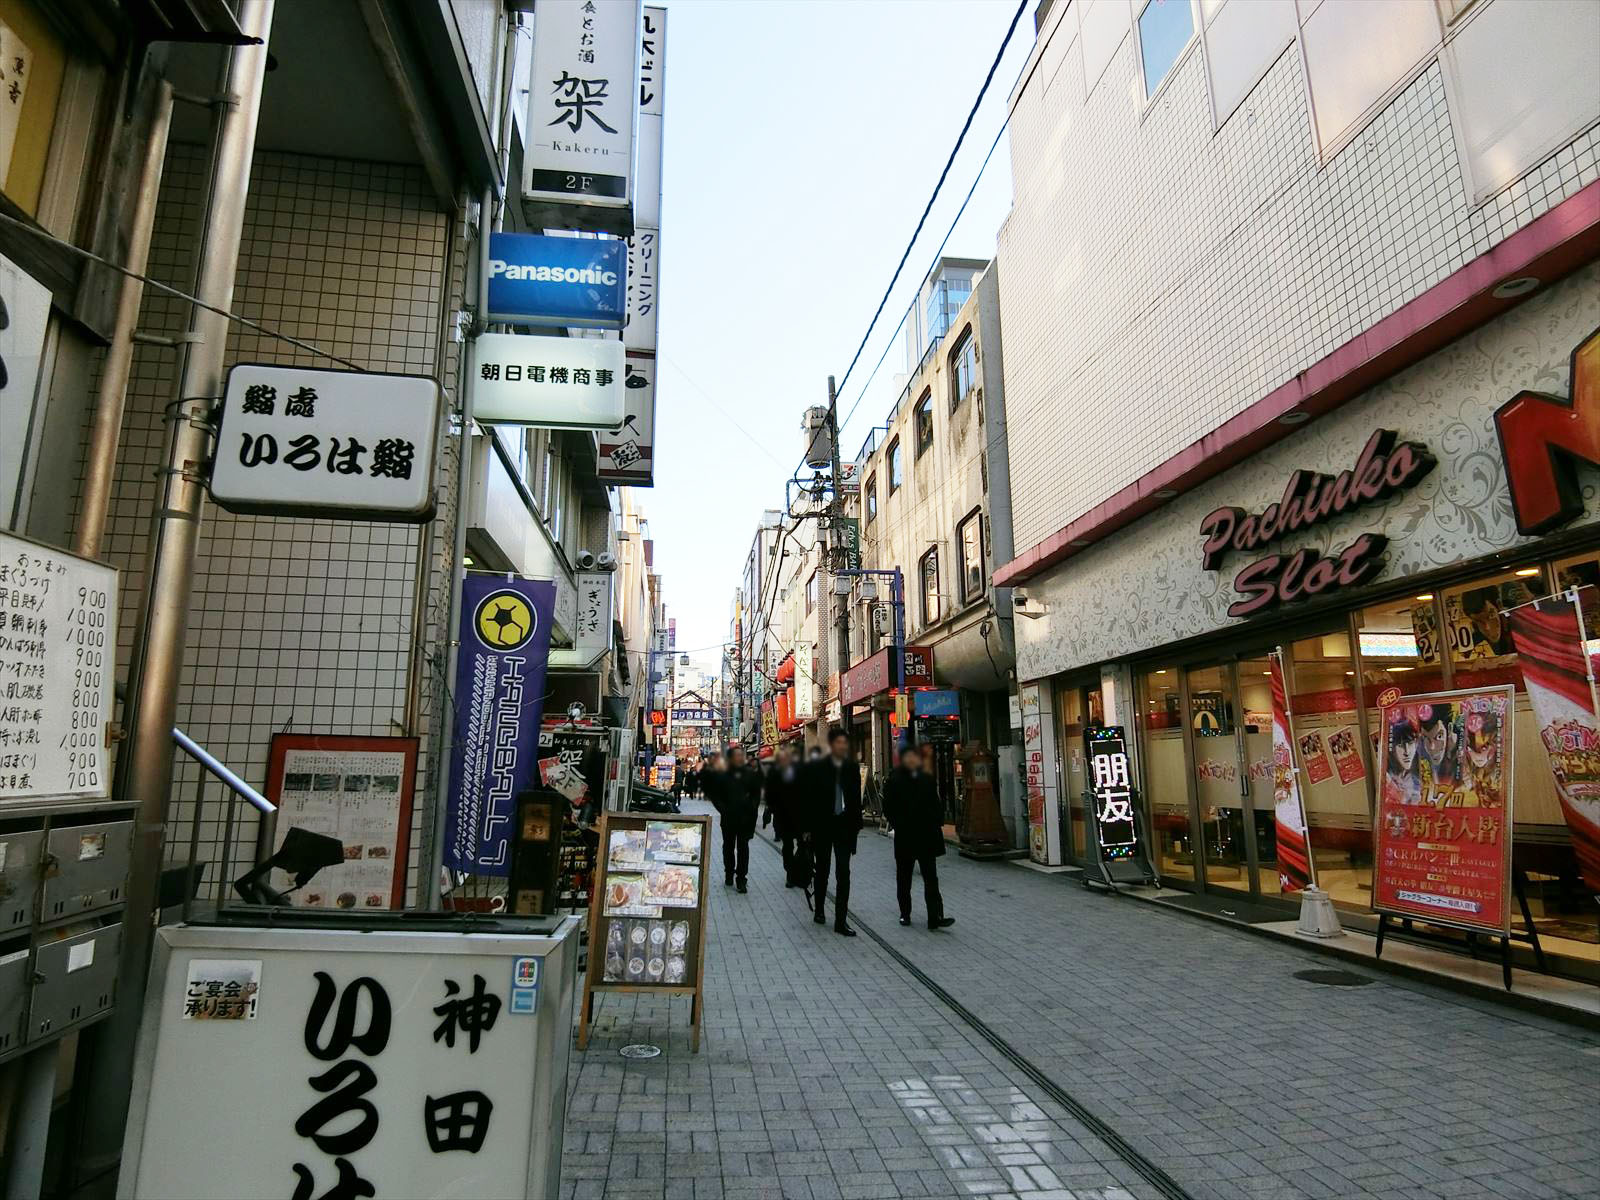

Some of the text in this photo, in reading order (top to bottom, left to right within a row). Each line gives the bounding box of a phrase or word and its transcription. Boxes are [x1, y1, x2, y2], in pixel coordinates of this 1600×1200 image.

[547, 70, 618, 134] 架
[552, 140, 609, 156] Kakeru
[566, 175, 593, 190] 2F
[488, 260, 617, 287] Panasonic
[638, 233, 654, 316] クリーニング
[481, 363, 614, 387] 朝日電機商事
[1200, 428, 1434, 571] Pachinko
[1228, 534, 1386, 618] Slot
[78, 586, 106, 609] 900
[67, 608, 105, 628] 1000
[587, 588, 601, 633] ぎょうざ
[66, 628, 104, 647] 1000
[76, 648, 101, 668] 900
[75, 669, 101, 688] 900
[72, 689, 100, 708] 800
[71, 711, 98, 730] 800
[69, 752, 96, 771] 900
[68, 771, 98, 790] 700
[1093, 753, 1134, 823] 朋友
[478, 838, 508, 866] 7
[187, 980, 242, 998] ご宴会
[183, 998, 257, 1019] 承ります!
[424, 973, 502, 1154] 神田
